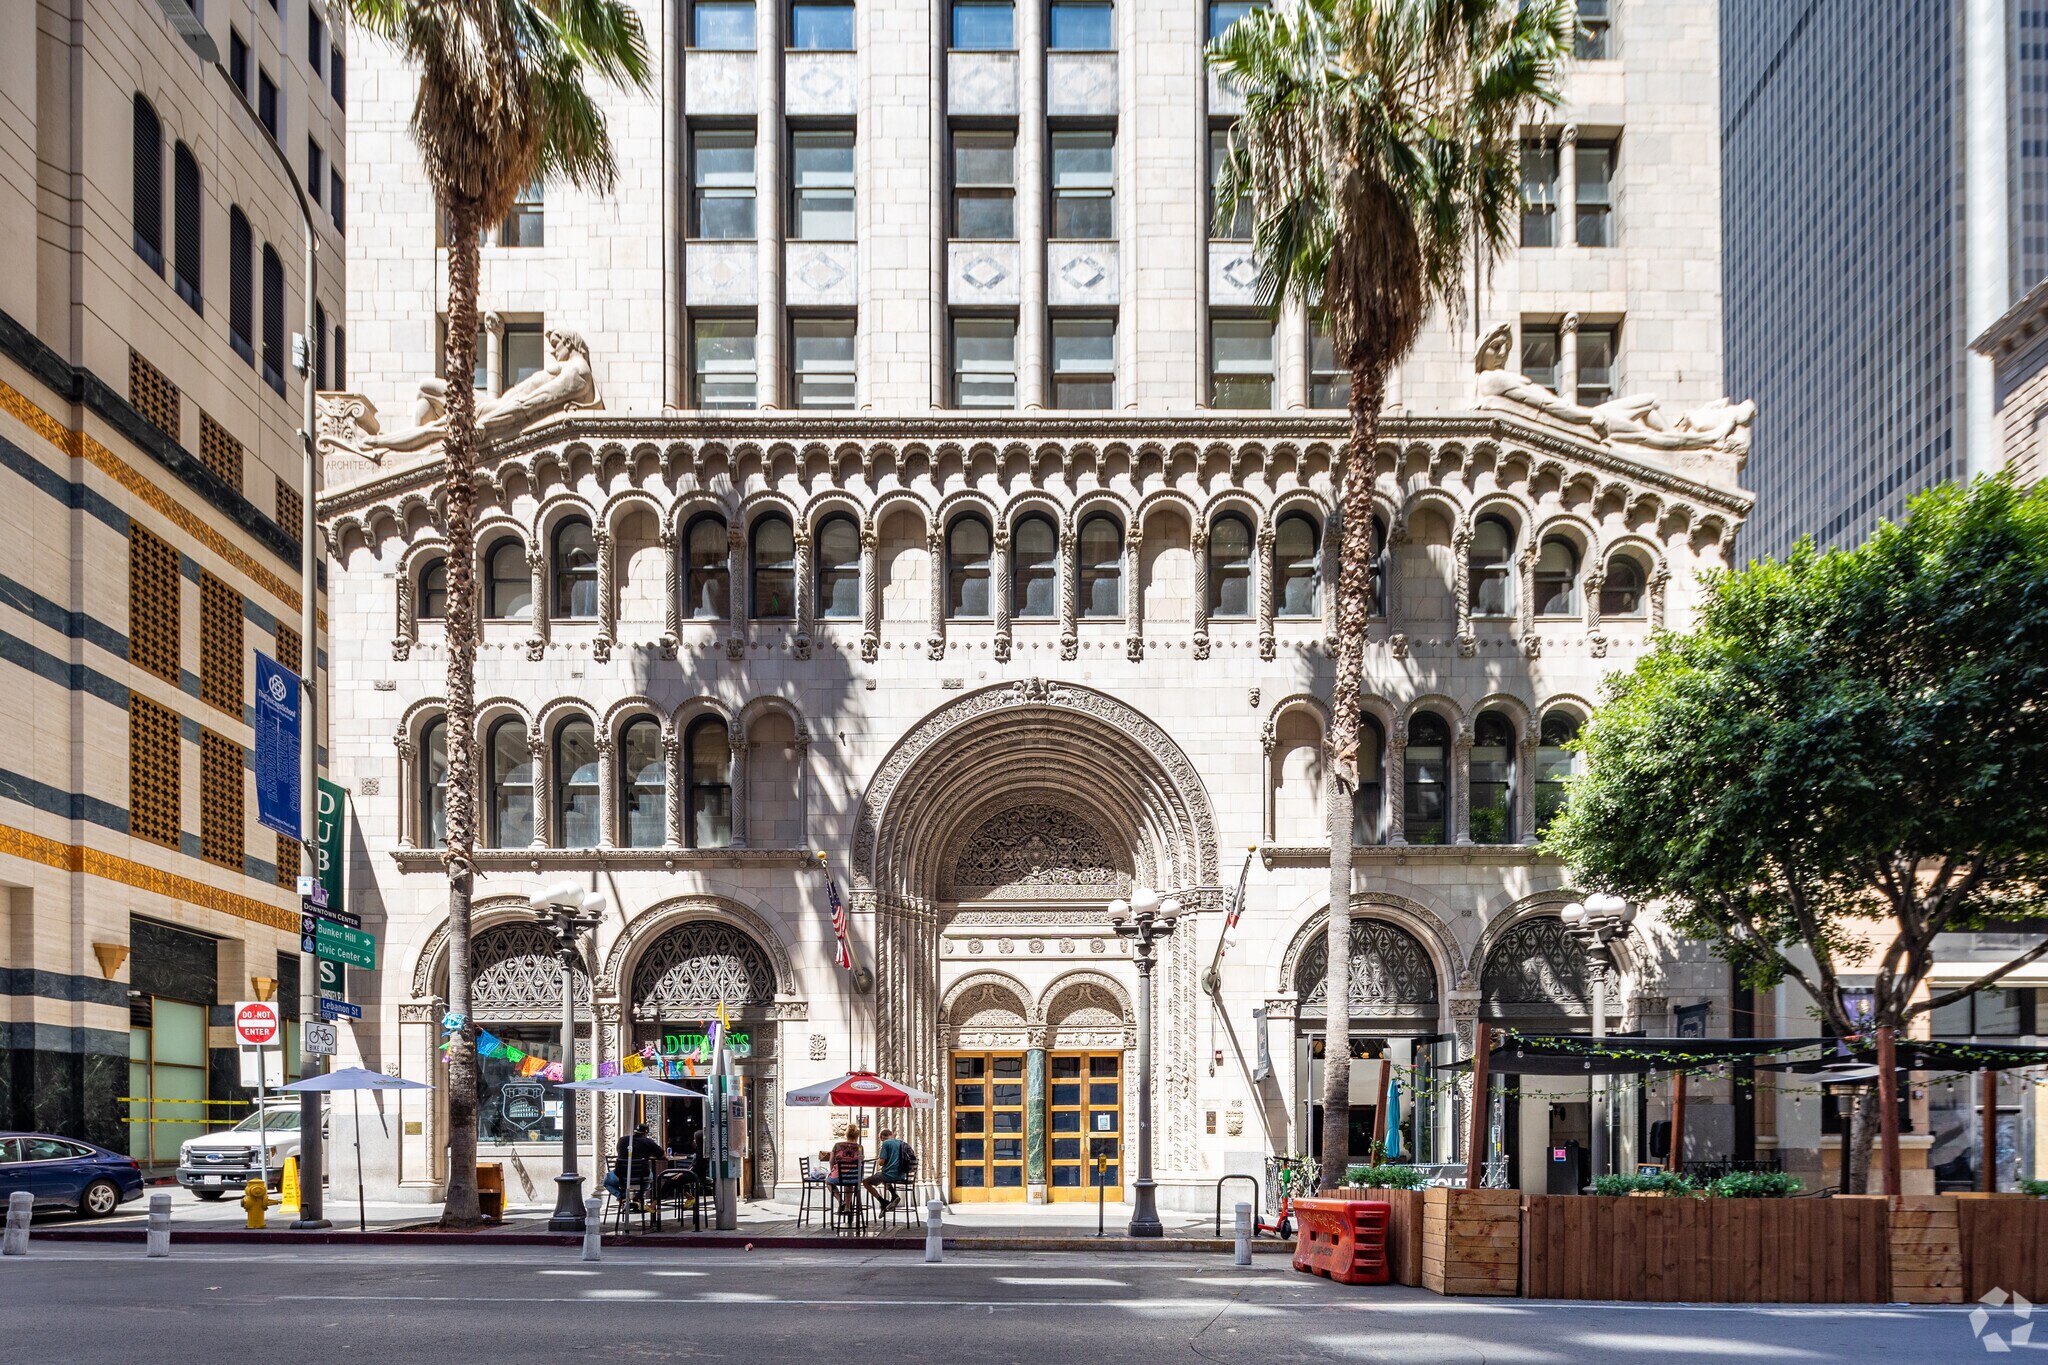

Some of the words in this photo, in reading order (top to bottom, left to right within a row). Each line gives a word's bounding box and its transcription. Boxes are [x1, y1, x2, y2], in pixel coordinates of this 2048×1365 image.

[266, 720, 279, 803] INNOVATION
[277, 729, 289, 784] SERVICE
[288, 731, 300, 812] COMMUNITY
[337, 913, 359, 926] CENTER
[318, 924, 343, 939] Bunker
[345, 931, 356, 943] Hill
[317, 942, 336, 955] Civic
[337, 948, 361, 962] Center
[242, 1011, 252, 1019] DO
[256, 1011, 271, 1019] NOT
[322, 1000, 350, 1014] Lebanon
[352, 1007, 359, 1016] St
[245, 1028, 270, 1036] ENTER
